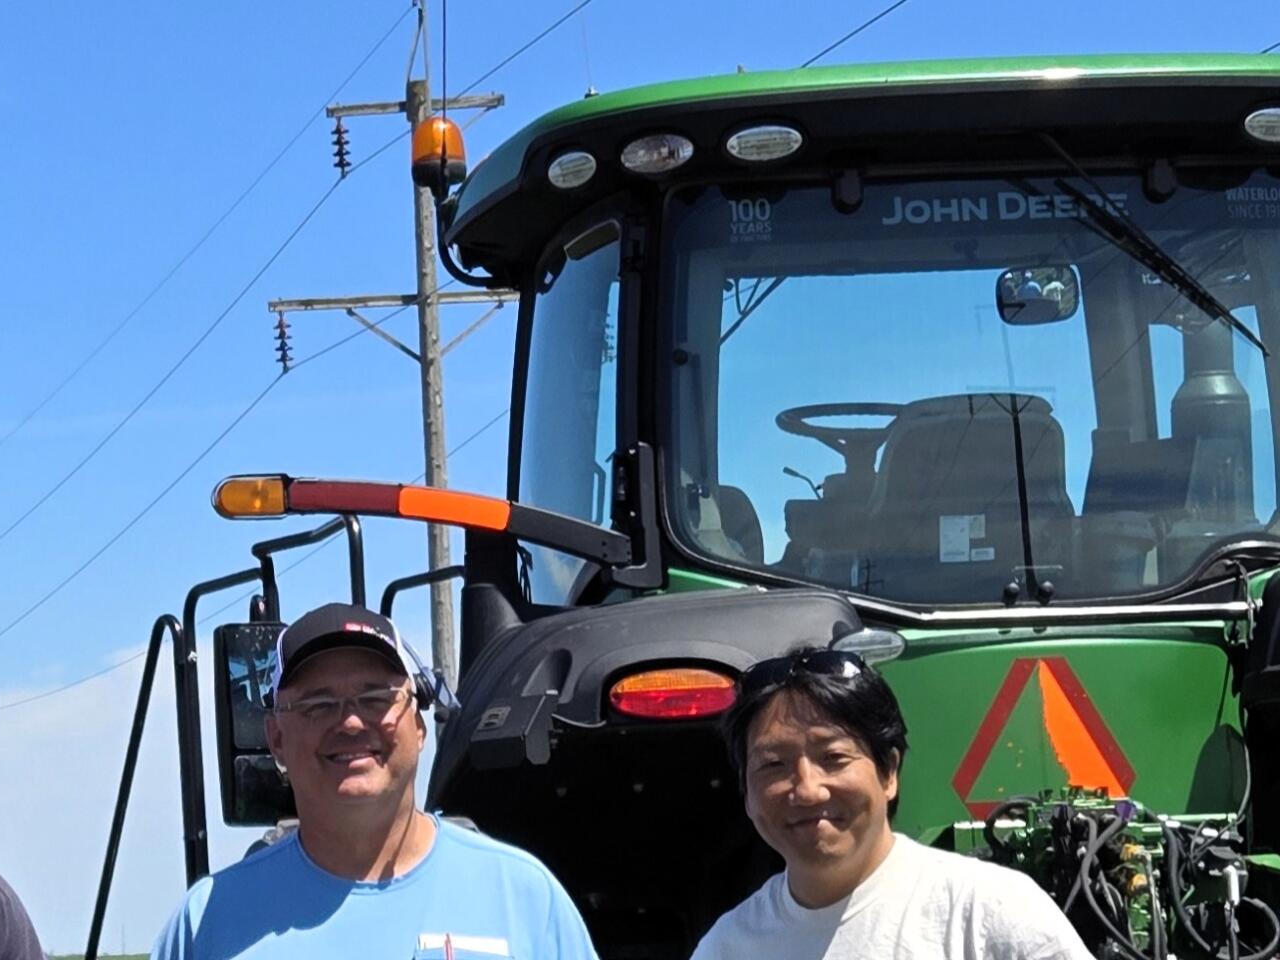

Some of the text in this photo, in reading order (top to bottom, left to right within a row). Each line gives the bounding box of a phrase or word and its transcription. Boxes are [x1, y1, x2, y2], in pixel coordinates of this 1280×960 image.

[1226, 187, 1280, 201] WATERLO
[728, 199, 771, 222] 100
[882, 196, 988, 225] JOHN
[730, 221, 773, 234] YEARS
